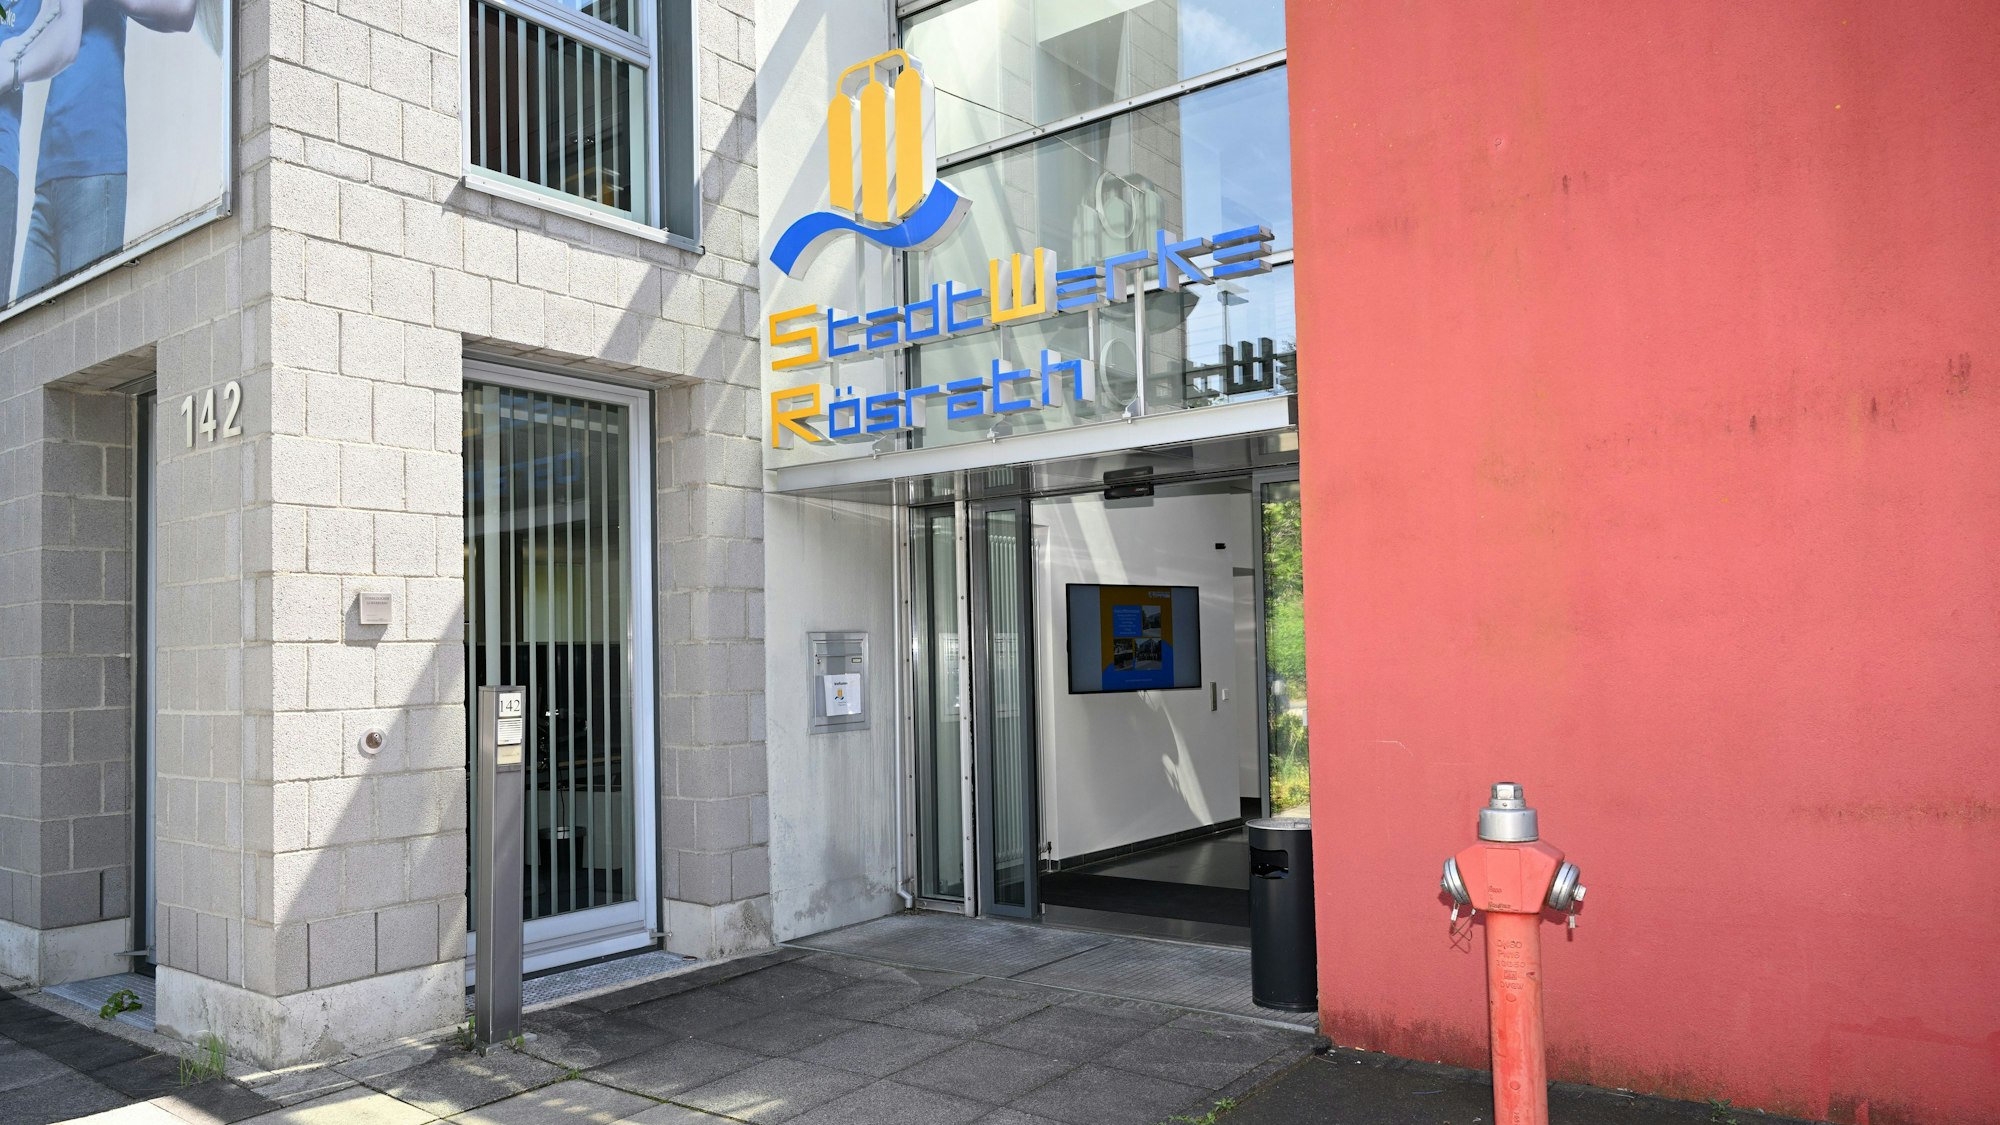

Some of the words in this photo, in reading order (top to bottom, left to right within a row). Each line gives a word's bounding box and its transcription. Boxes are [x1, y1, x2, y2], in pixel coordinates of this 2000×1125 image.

[180, 380, 242, 448] 142
[770, 349, 1090, 448] Rösrath
[500, 699, 520, 713] 142
